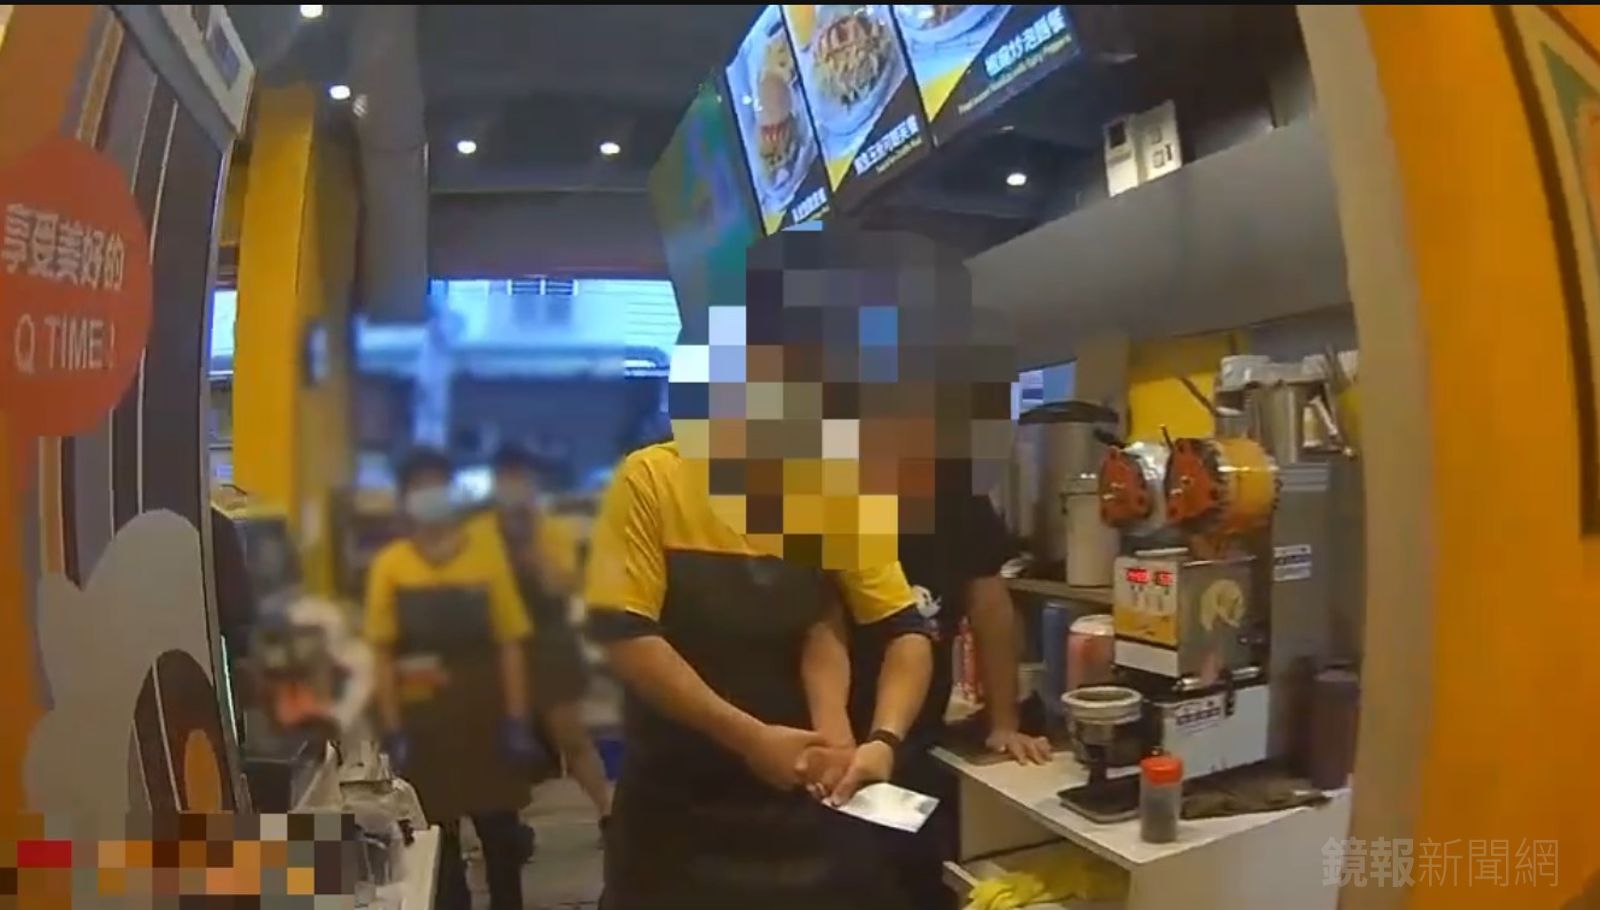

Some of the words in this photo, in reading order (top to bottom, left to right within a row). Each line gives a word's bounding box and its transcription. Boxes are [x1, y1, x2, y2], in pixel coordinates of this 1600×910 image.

[1, 203, 125, 291] 享受美好的
[14, 313, 36, 375] Q
